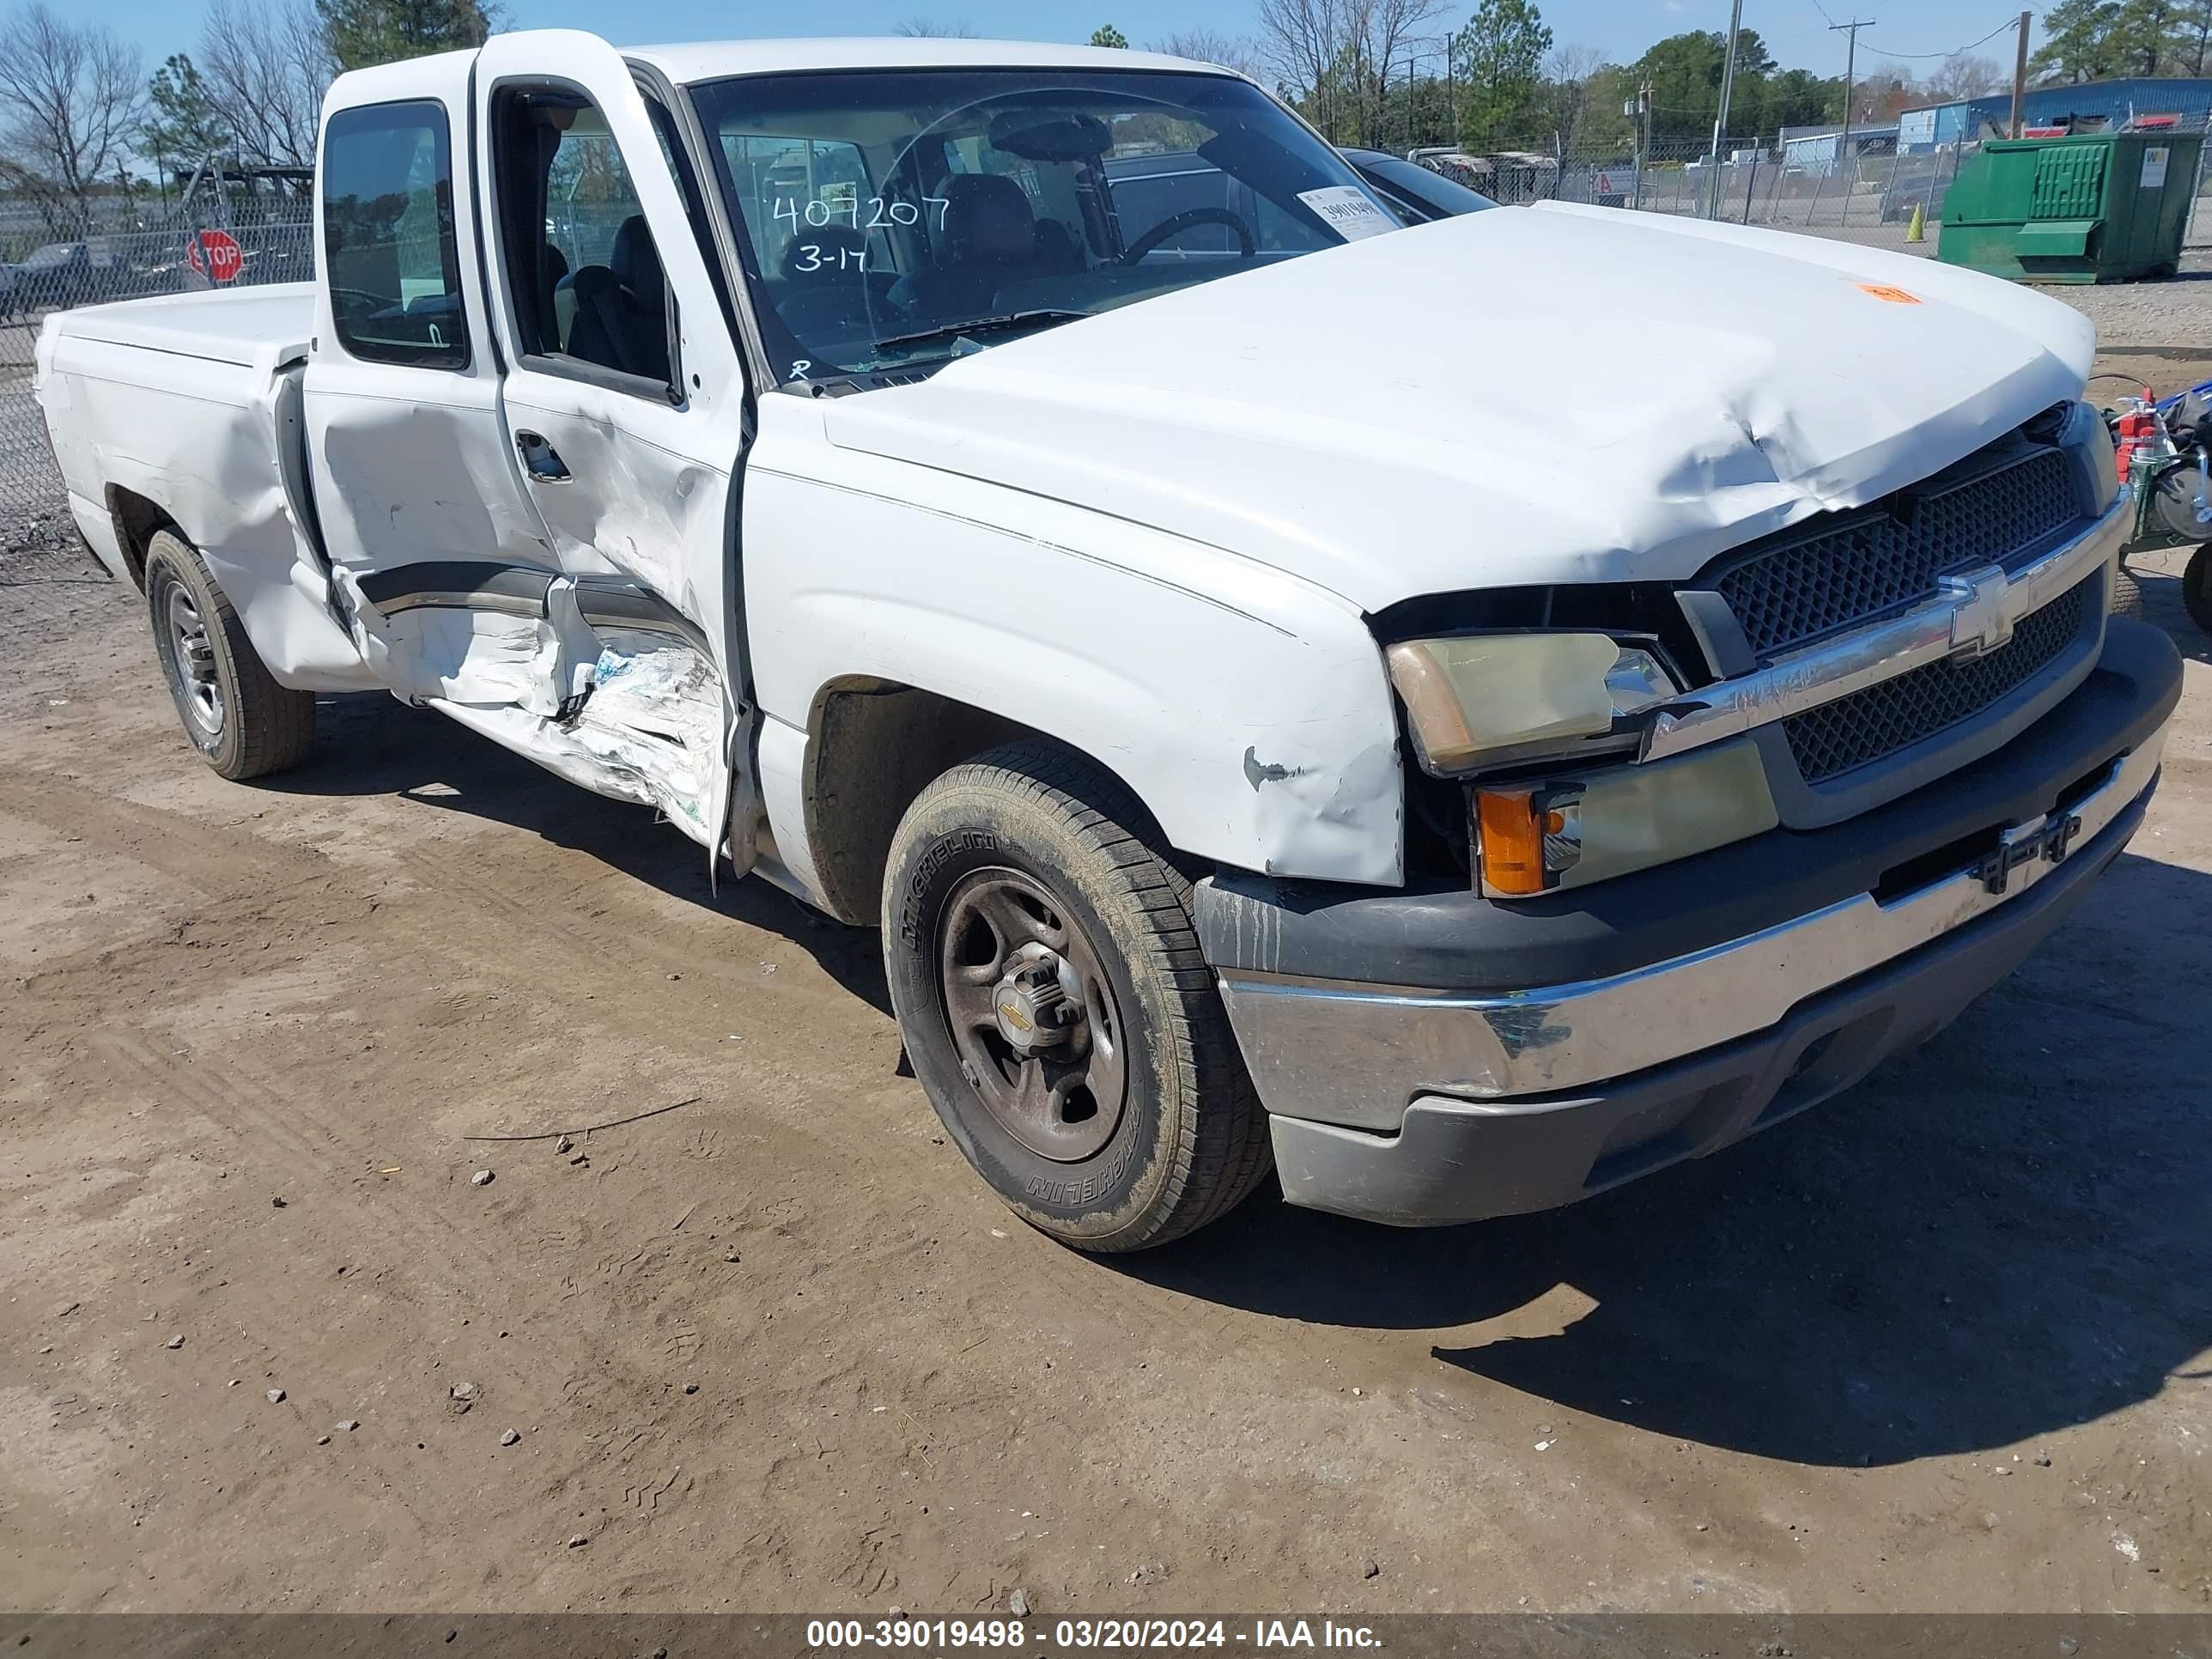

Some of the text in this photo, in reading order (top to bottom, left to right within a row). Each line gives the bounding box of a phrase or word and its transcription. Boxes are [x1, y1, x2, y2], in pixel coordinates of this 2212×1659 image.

[773, 197, 950, 236] 407207
[192, 246, 237, 266] STOP
[795, 245, 866, 272] 3-17
[788, 360, 811, 380] R
[902, 830, 996, 950] MICHELIN
[1026, 1099, 1141, 1204] MICHELIN
